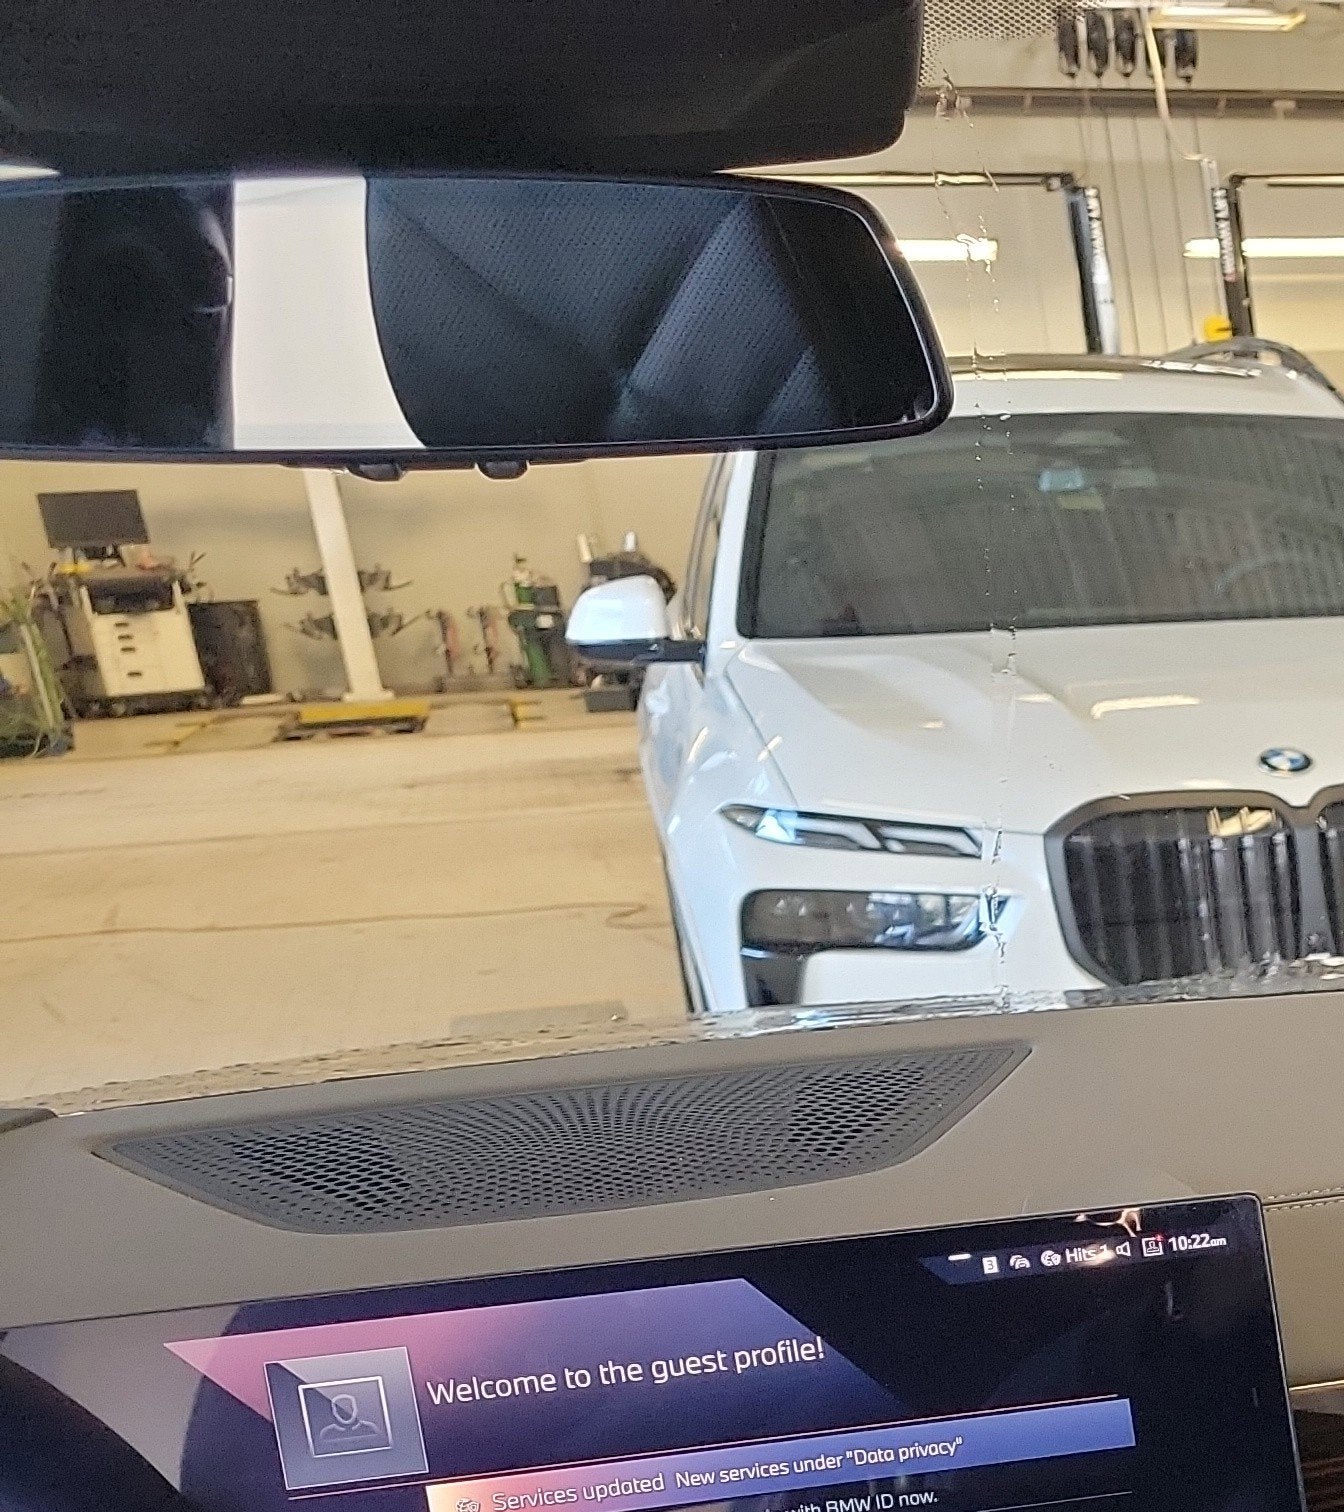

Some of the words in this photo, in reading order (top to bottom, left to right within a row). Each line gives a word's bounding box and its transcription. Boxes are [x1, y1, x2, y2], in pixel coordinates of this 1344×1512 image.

[1065, 1247, 1096, 1263] Hits
[1168, 1233, 1227, 1251] 10:22am
[427, 1373, 557, 1405] Welcome
[564, 1367, 591, 1389] to
[599, 1361, 643, 1385] the
[652, 1350, 727, 1384] guest
[734, 1336, 825, 1374] profile!
[492, 1487, 577, 1511] Services
[583, 1473, 665, 1503] updated
[675, 1470, 715, 1488] New
[719, 1458, 790, 1483] services
[794, 1454, 843, 1473] under
[846, 1449, 895, 1466] "Data
[899, 1436, 963, 1462] privacy"
[875, 1494, 894, 1510] ID
[899, 1490, 938, 1507] now.
